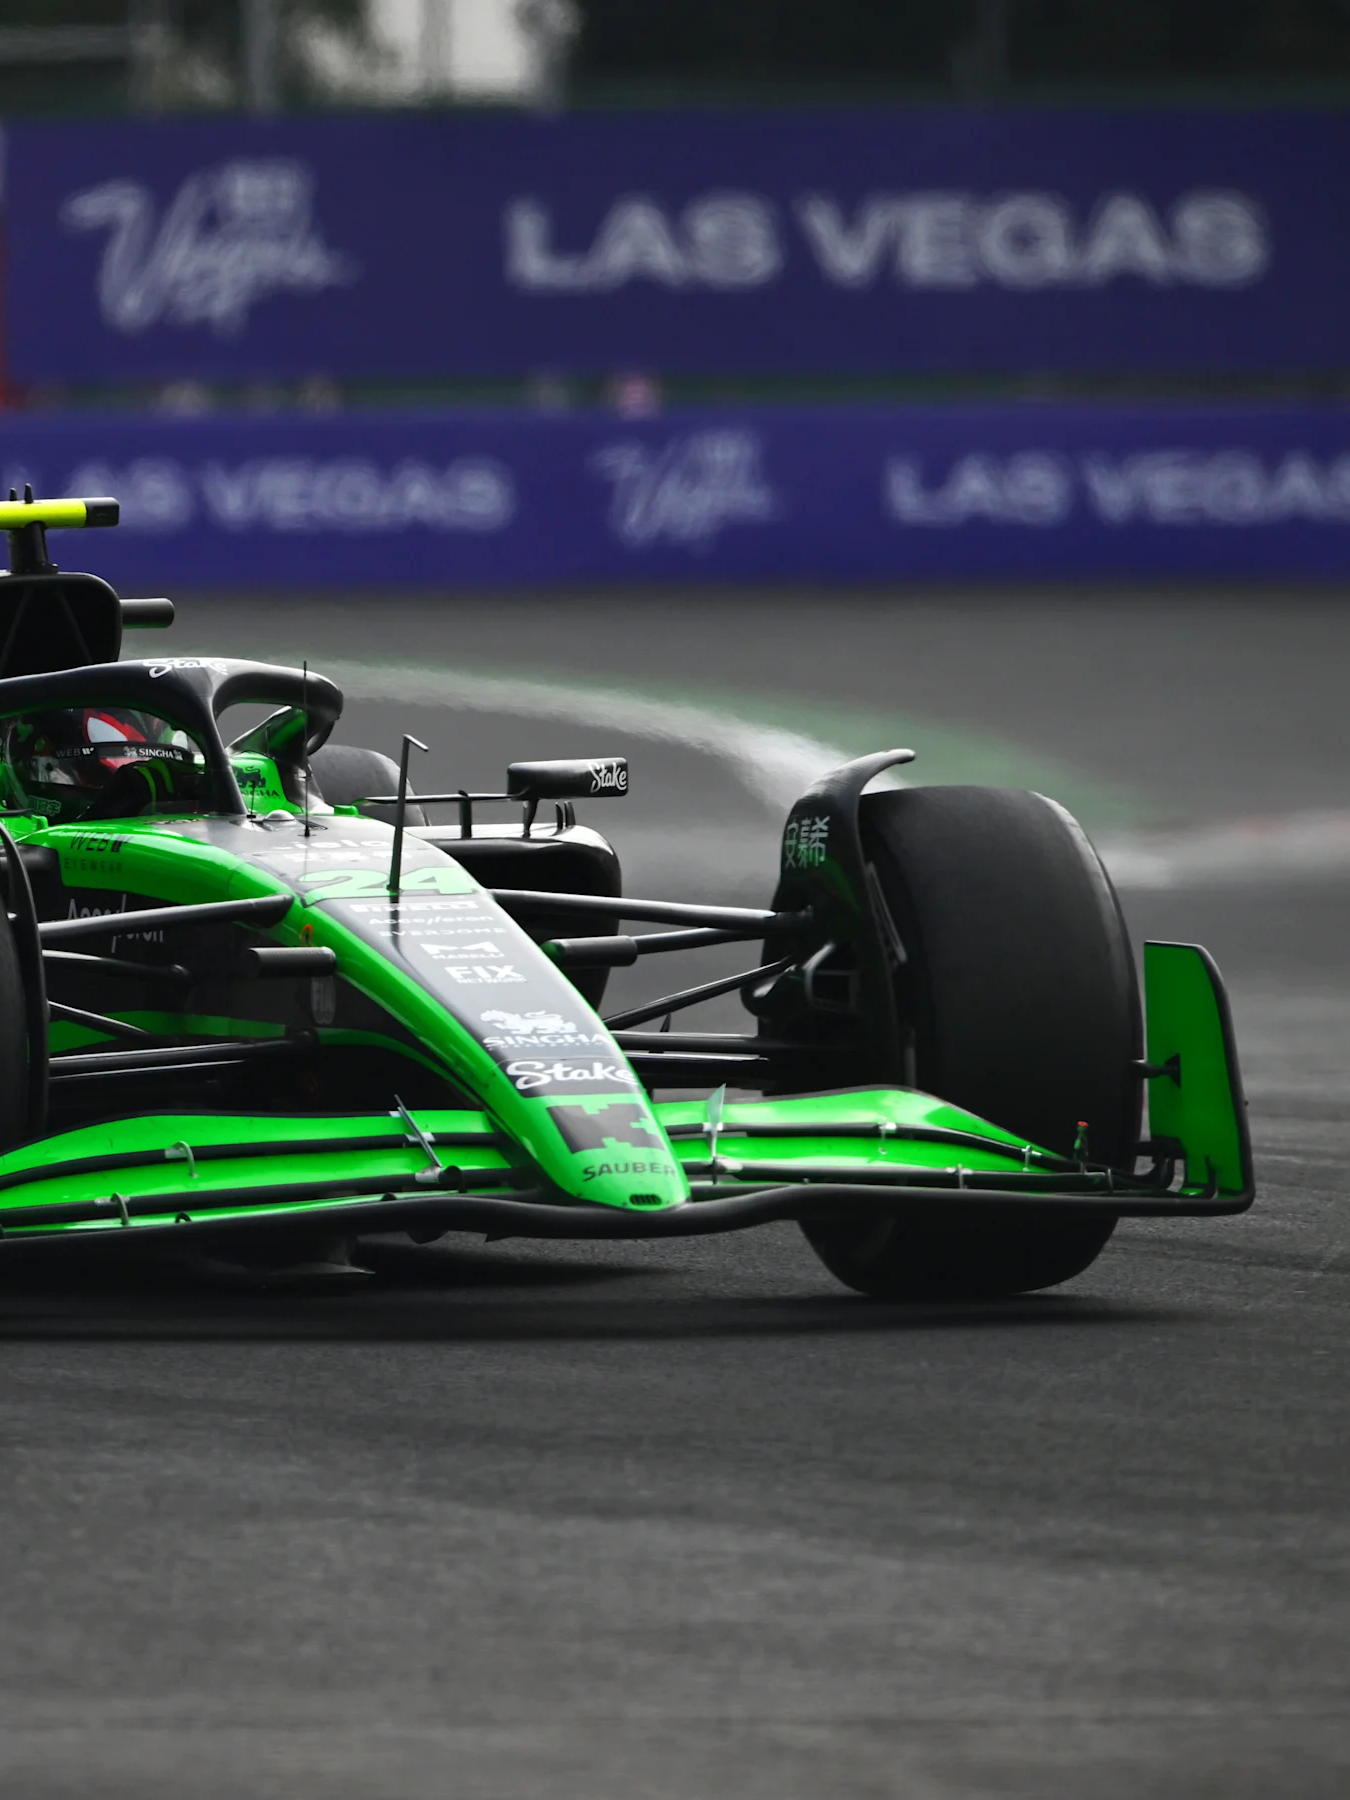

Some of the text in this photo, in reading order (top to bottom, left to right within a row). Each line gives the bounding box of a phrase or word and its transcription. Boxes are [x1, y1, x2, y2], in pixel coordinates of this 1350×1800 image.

[507, 192, 1267, 290] LAS VEGAS
[886, 454, 1074, 527] LAS
[139, 748, 174, 758] SINGHA
[589, 762, 628, 792] Stake
[69, 833, 112, 851] WEB
[64, 857, 122, 873] EYEWEAR
[300, 867, 477, 905] 24
[445, 965, 525, 980] FIX
[482, 1034, 614, 1046] SINGHA
[507, 1061, 637, 1090] Stake
[583, 1162, 677, 1181] SAUBER
